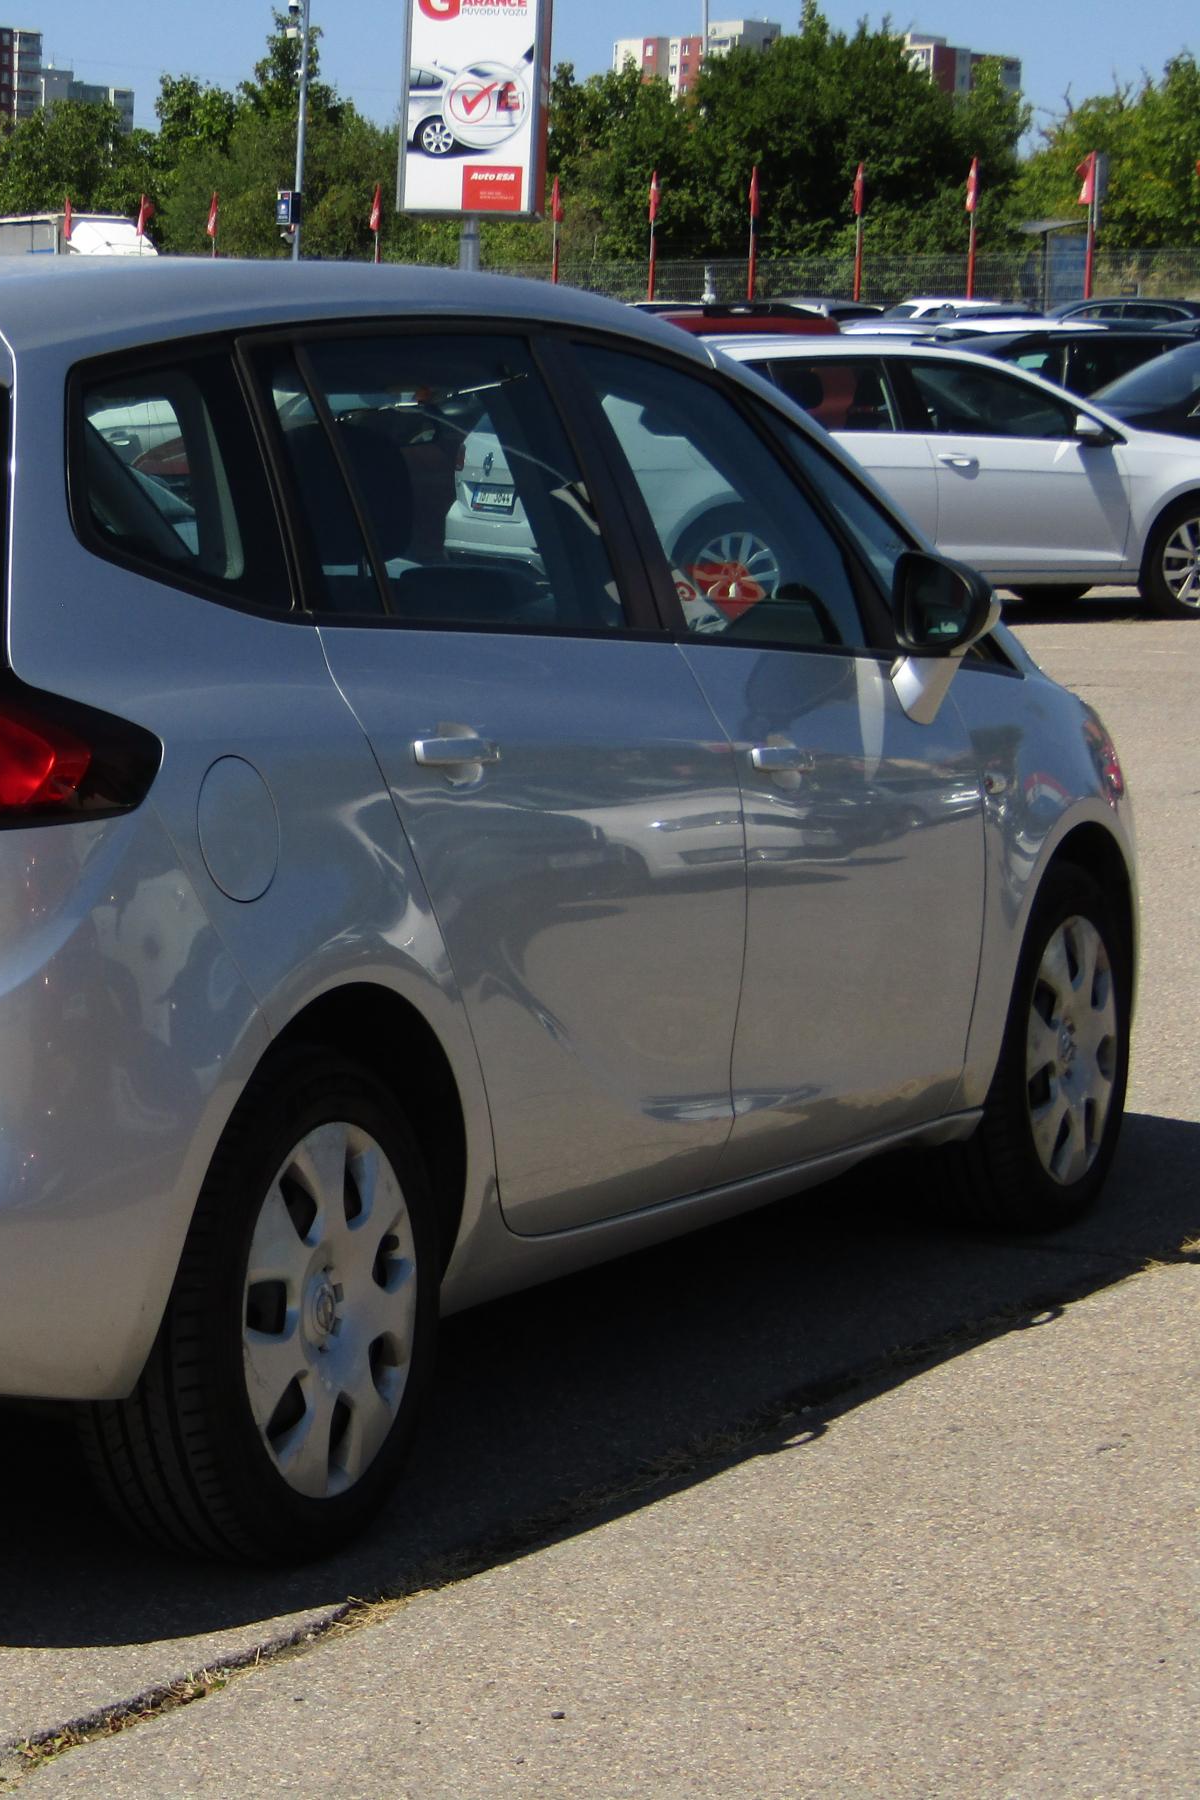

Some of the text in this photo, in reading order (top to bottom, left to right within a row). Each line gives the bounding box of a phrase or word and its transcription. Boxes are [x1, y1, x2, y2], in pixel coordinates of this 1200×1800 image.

[502, 7, 528, 16] VOZU
[470, 172, 516, 182] Auto ESA
